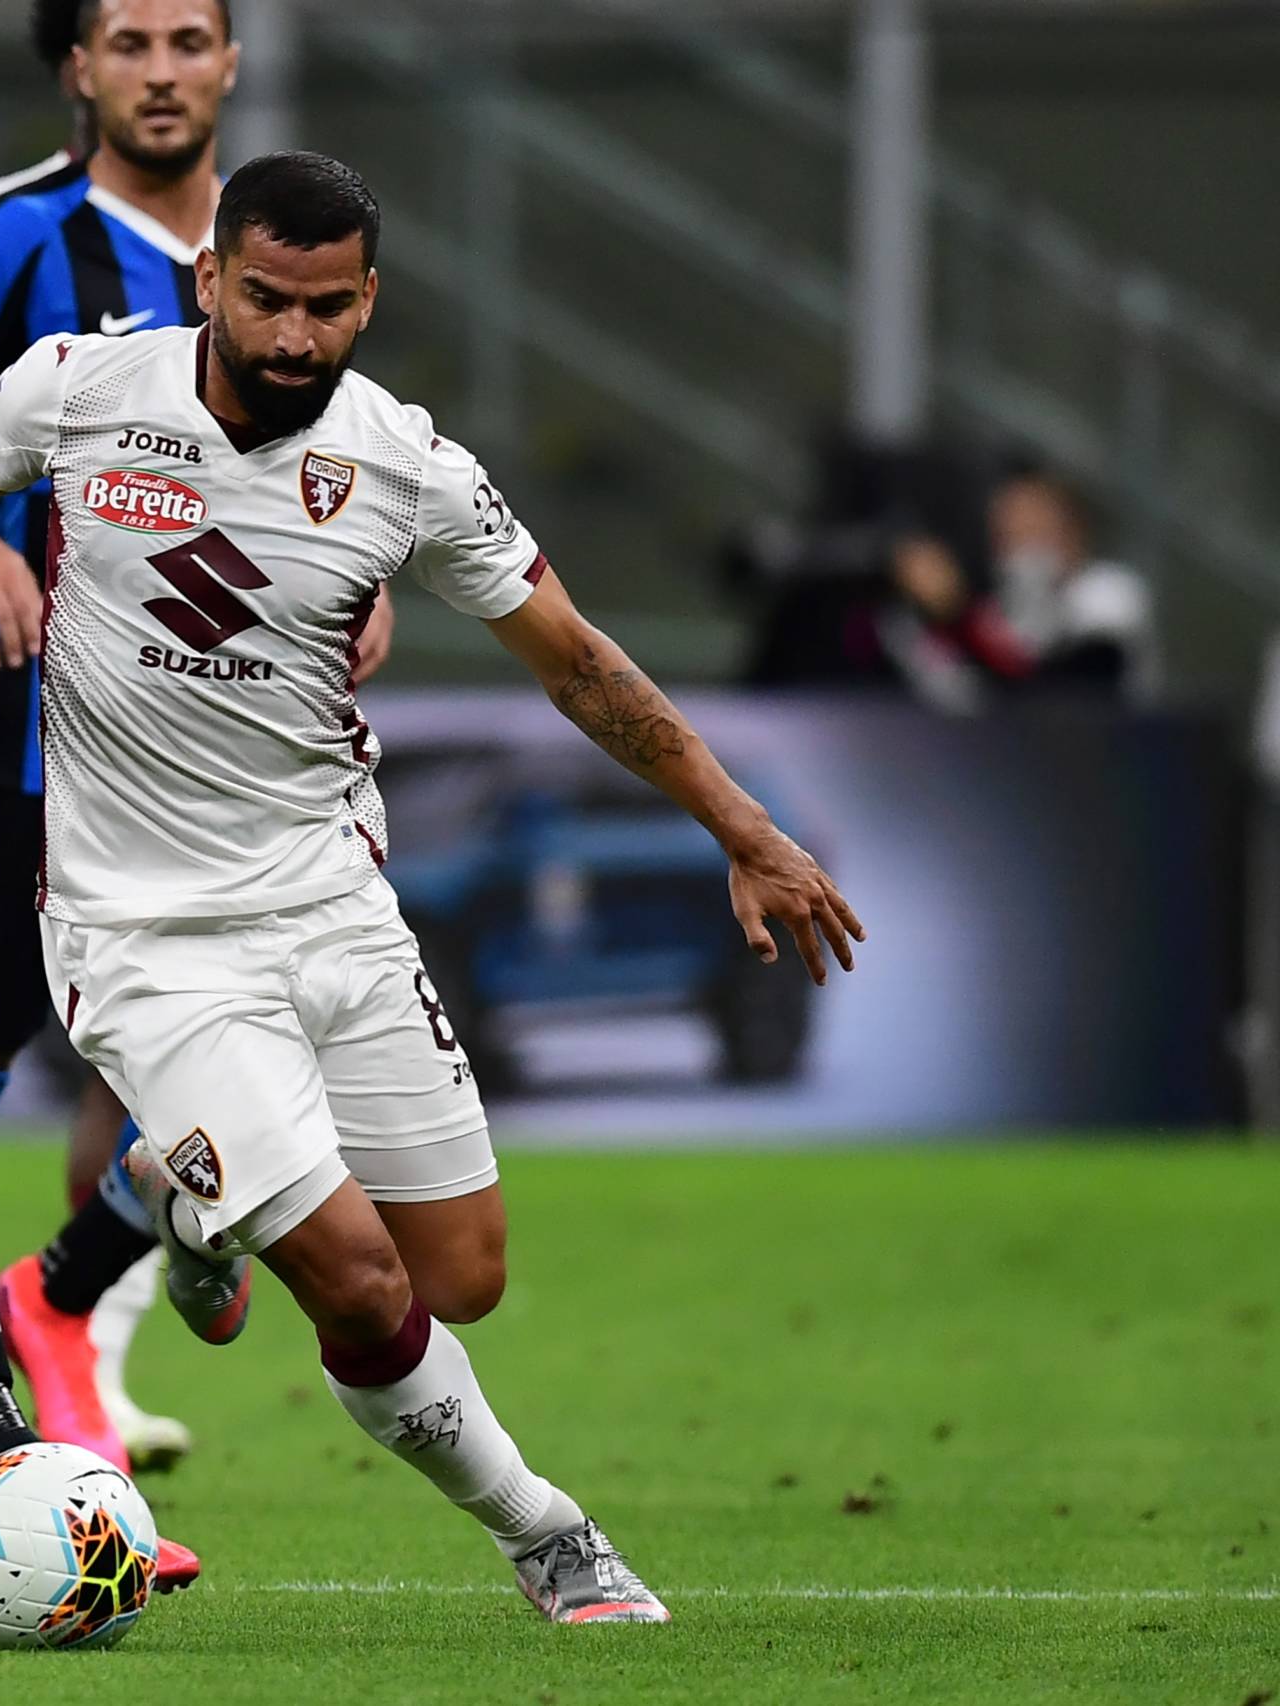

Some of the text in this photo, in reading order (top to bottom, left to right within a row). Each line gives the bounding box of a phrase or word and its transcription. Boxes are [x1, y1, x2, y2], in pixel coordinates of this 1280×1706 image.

[117, 428, 202, 464] Joma
[120, 472, 170, 492] Fratelli
[309, 459, 348, 480] TORINO
[85, 477, 204, 524] Beretta
[330, 481, 347, 495] FC
[120, 513, 157, 529] 1812
[137, 645, 273, 681] SUZUKI
[414, 967, 457, 1052] 8
[172, 1137, 203, 1168] TORINO
